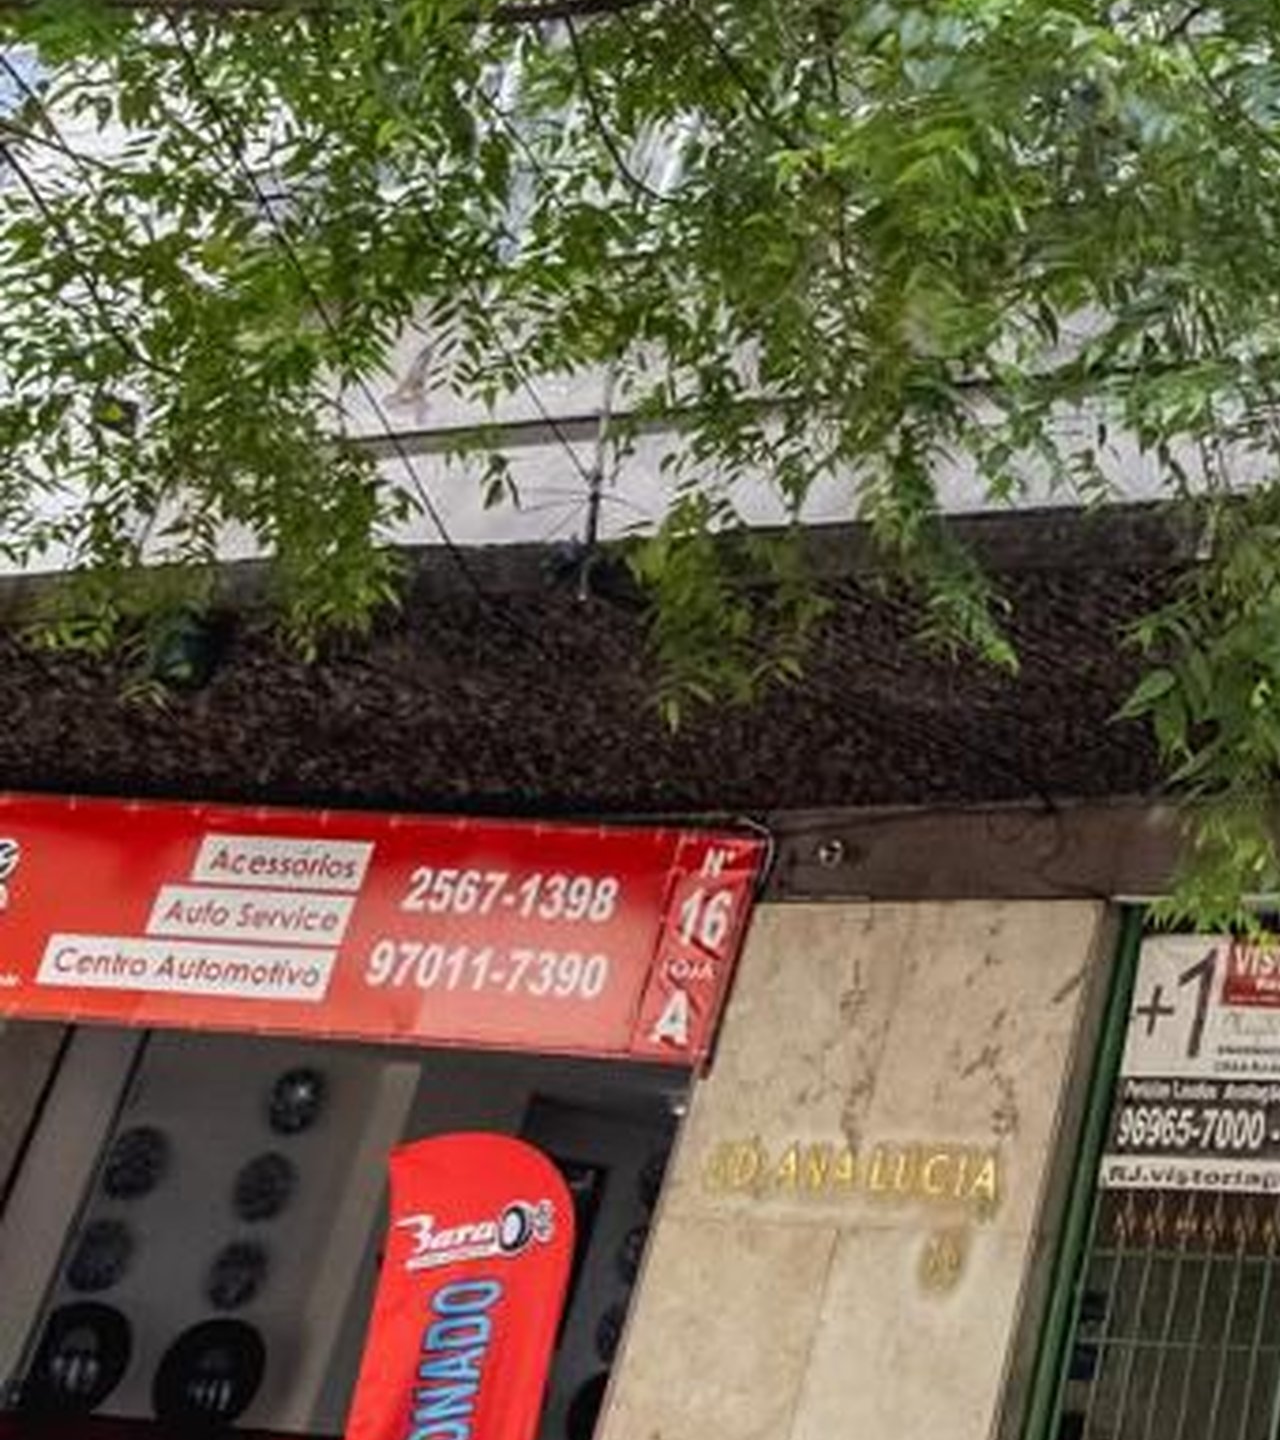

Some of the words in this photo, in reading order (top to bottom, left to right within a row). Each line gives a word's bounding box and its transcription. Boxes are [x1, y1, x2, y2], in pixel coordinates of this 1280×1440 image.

[209, 848, 357, 880] Acessórios
[164, 899, 229, 928] Auto
[236, 901, 339, 932] Service
[402, 865, 619, 921] 2567-1398
[679, 886, 733, 950] 16
[54, 946, 148, 977] Centro
[156, 953, 321, 989] Automotivo
[364, 938, 608, 1000] 97011-7390
[650, 988, 690, 1047] A
